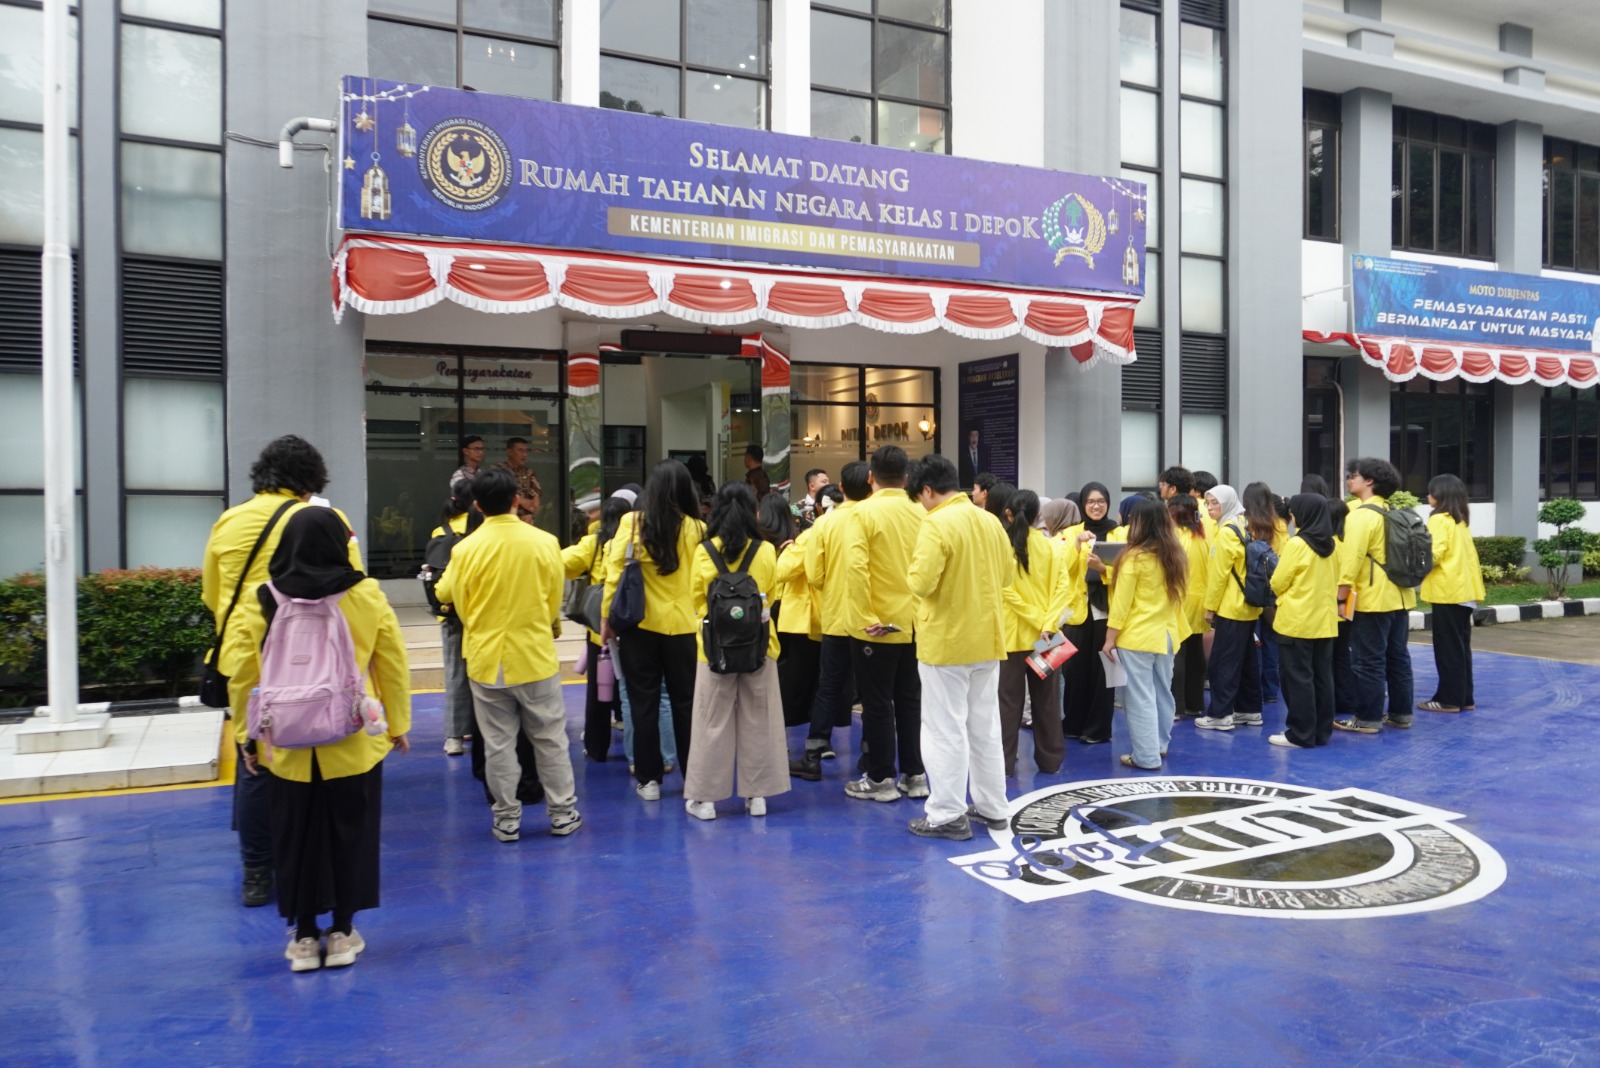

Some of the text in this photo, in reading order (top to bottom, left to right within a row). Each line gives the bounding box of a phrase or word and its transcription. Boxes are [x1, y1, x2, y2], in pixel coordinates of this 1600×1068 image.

[418, 118, 513, 187] KEMENTERIAN IMIGRASI DAN PEMASYARAKATAN
[689, 142, 910, 193] SELAMAT DATANG
[431, 188, 501, 210] REPUBLIK INDONESIA
[518, 158, 1041, 240] RUMAH TAHANAN NEGARA KELAS I DEPOK
[630, 214, 955, 261] KEMENTERIAN IMIGRASI DAN PEMASYARAKATAN
[1469, 284, 1540, 302] MOTO DIRJENPAS
[1376, 311, 1596, 341] BERMANFAAT UNTUK MASYARA
[1413, 298, 1587, 325] PEMASYARAKATAN PASTI
[874, 421, 909, 441] DEPOK
